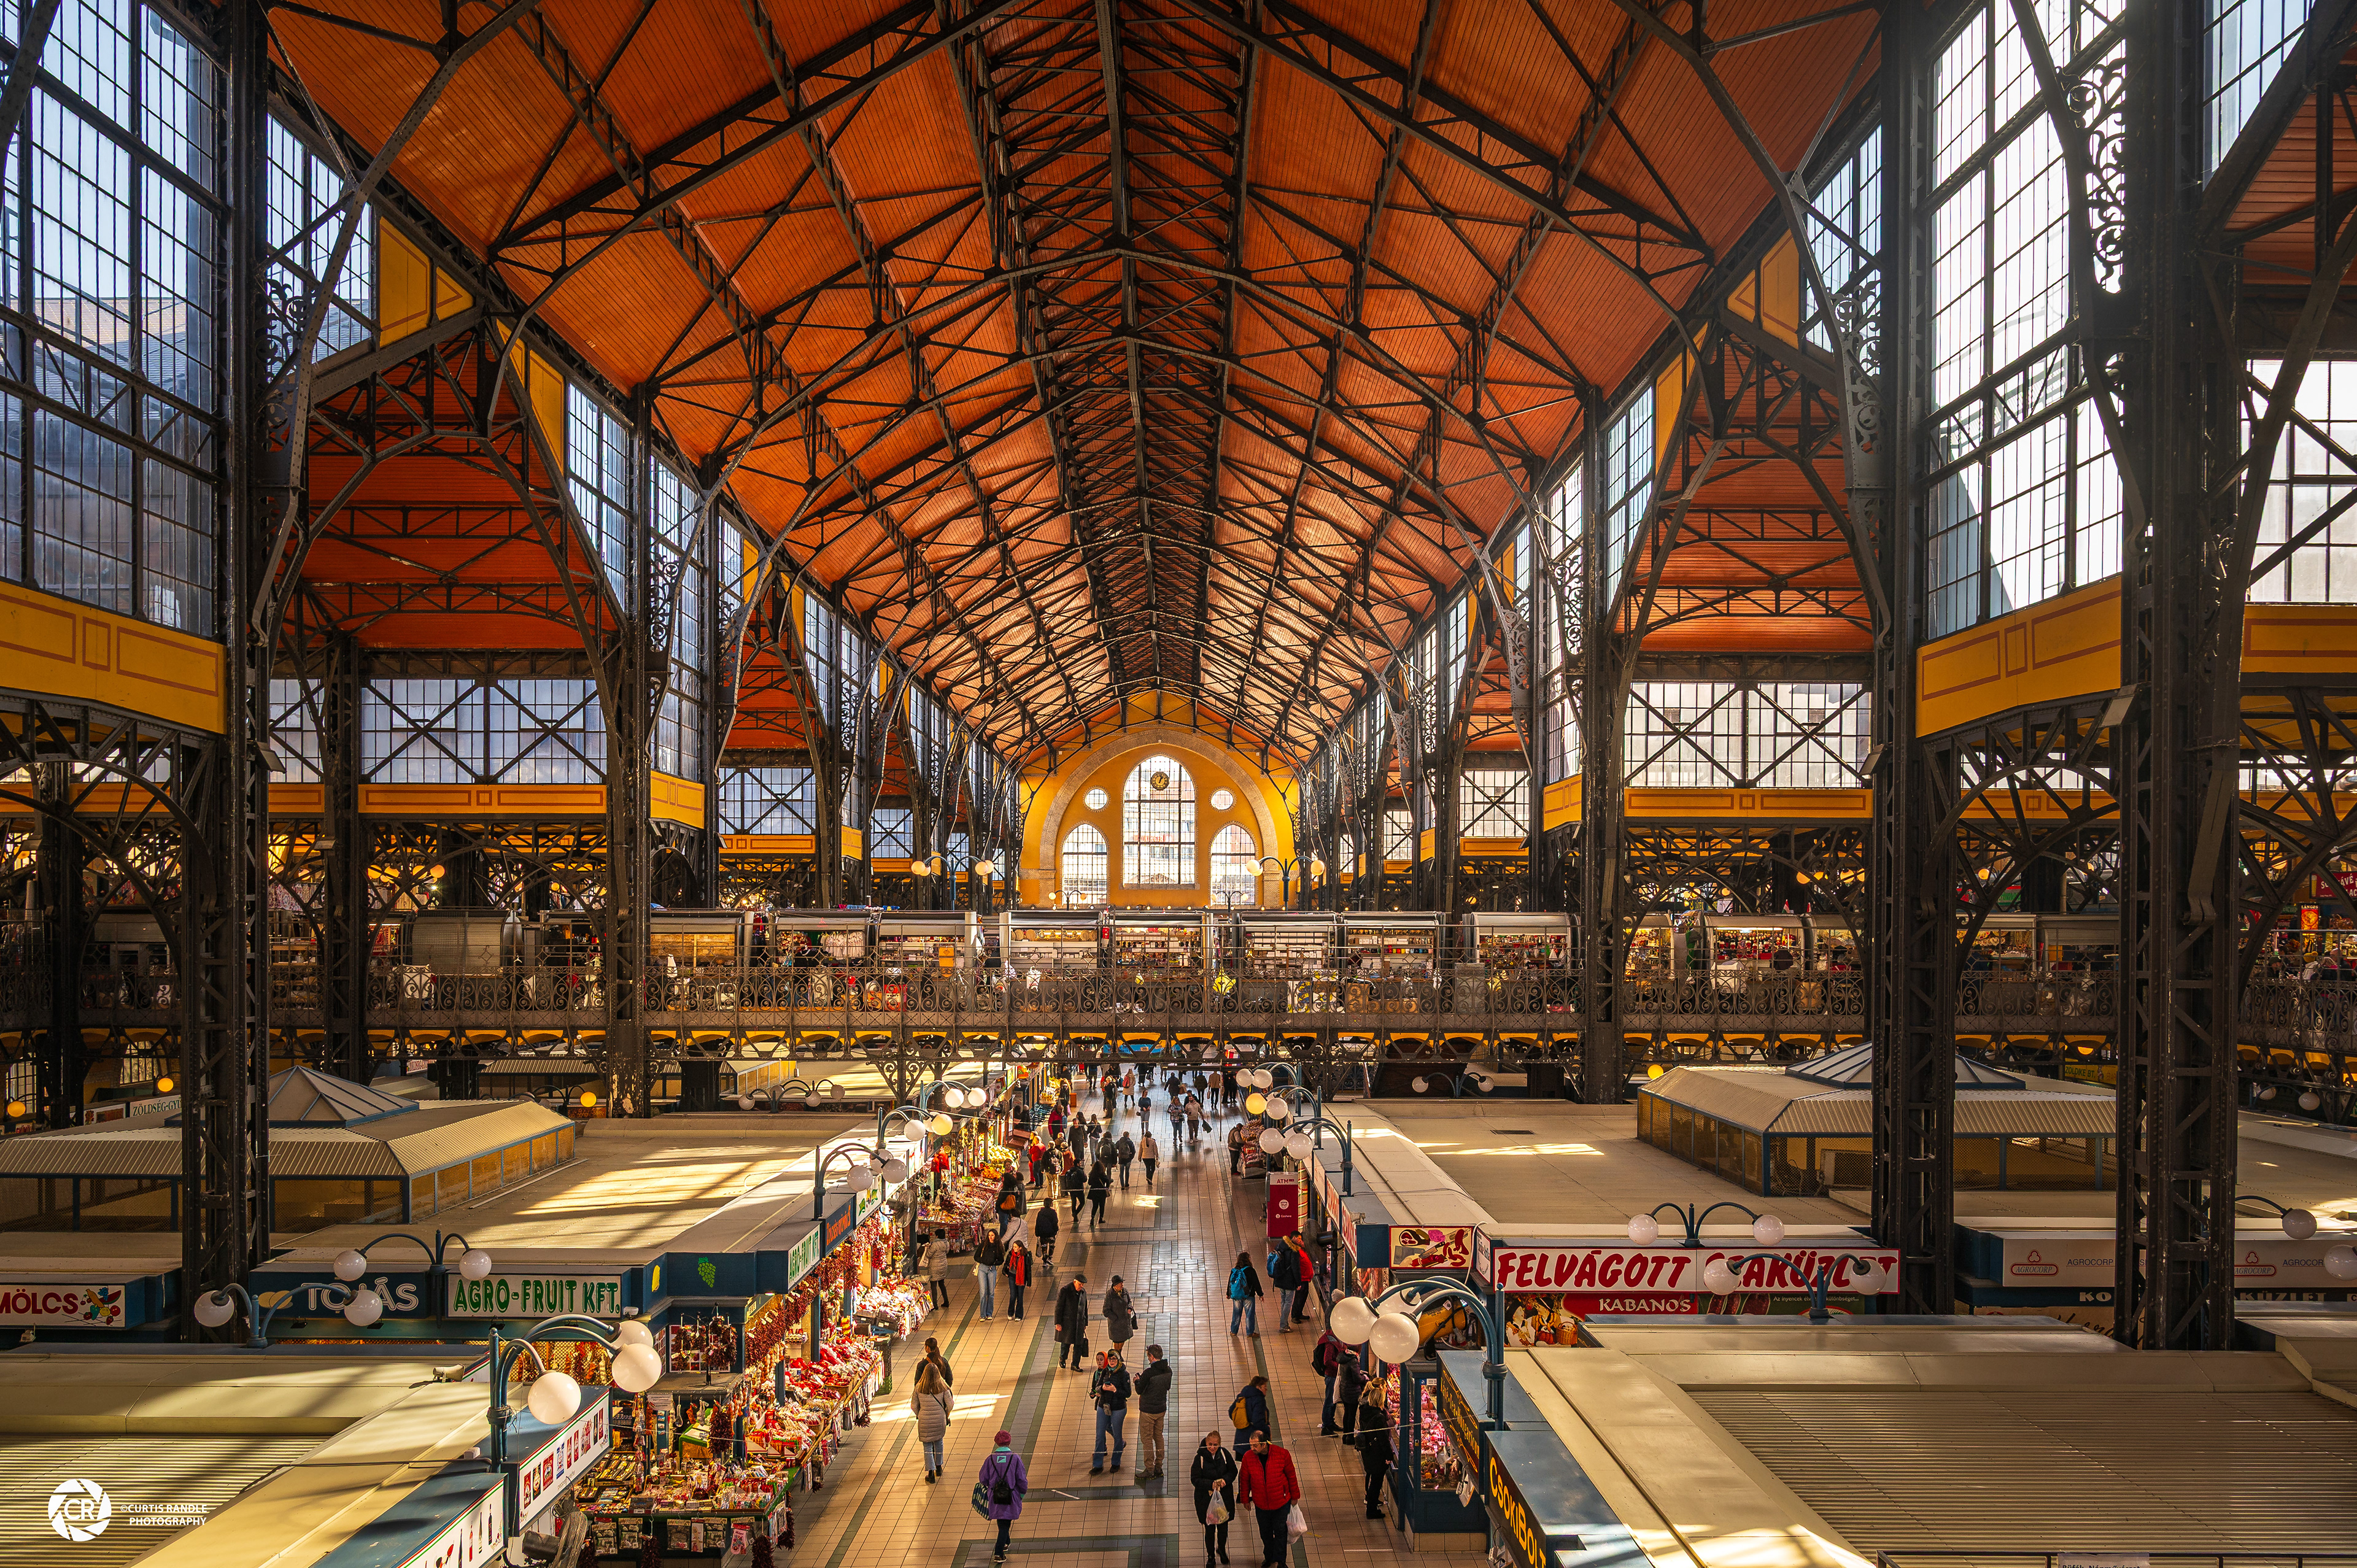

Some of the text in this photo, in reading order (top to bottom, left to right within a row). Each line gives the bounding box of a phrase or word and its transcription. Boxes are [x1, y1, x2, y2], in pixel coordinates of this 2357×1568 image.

[1498, 1249, 1691, 1288] FELVÁGOTT
[301, 1276, 419, 1311] TOÁS
[454, 1278, 620, 1314] AGRO-FRUIT KFT.
[1598, 1298, 1691, 1312] KABANOS
